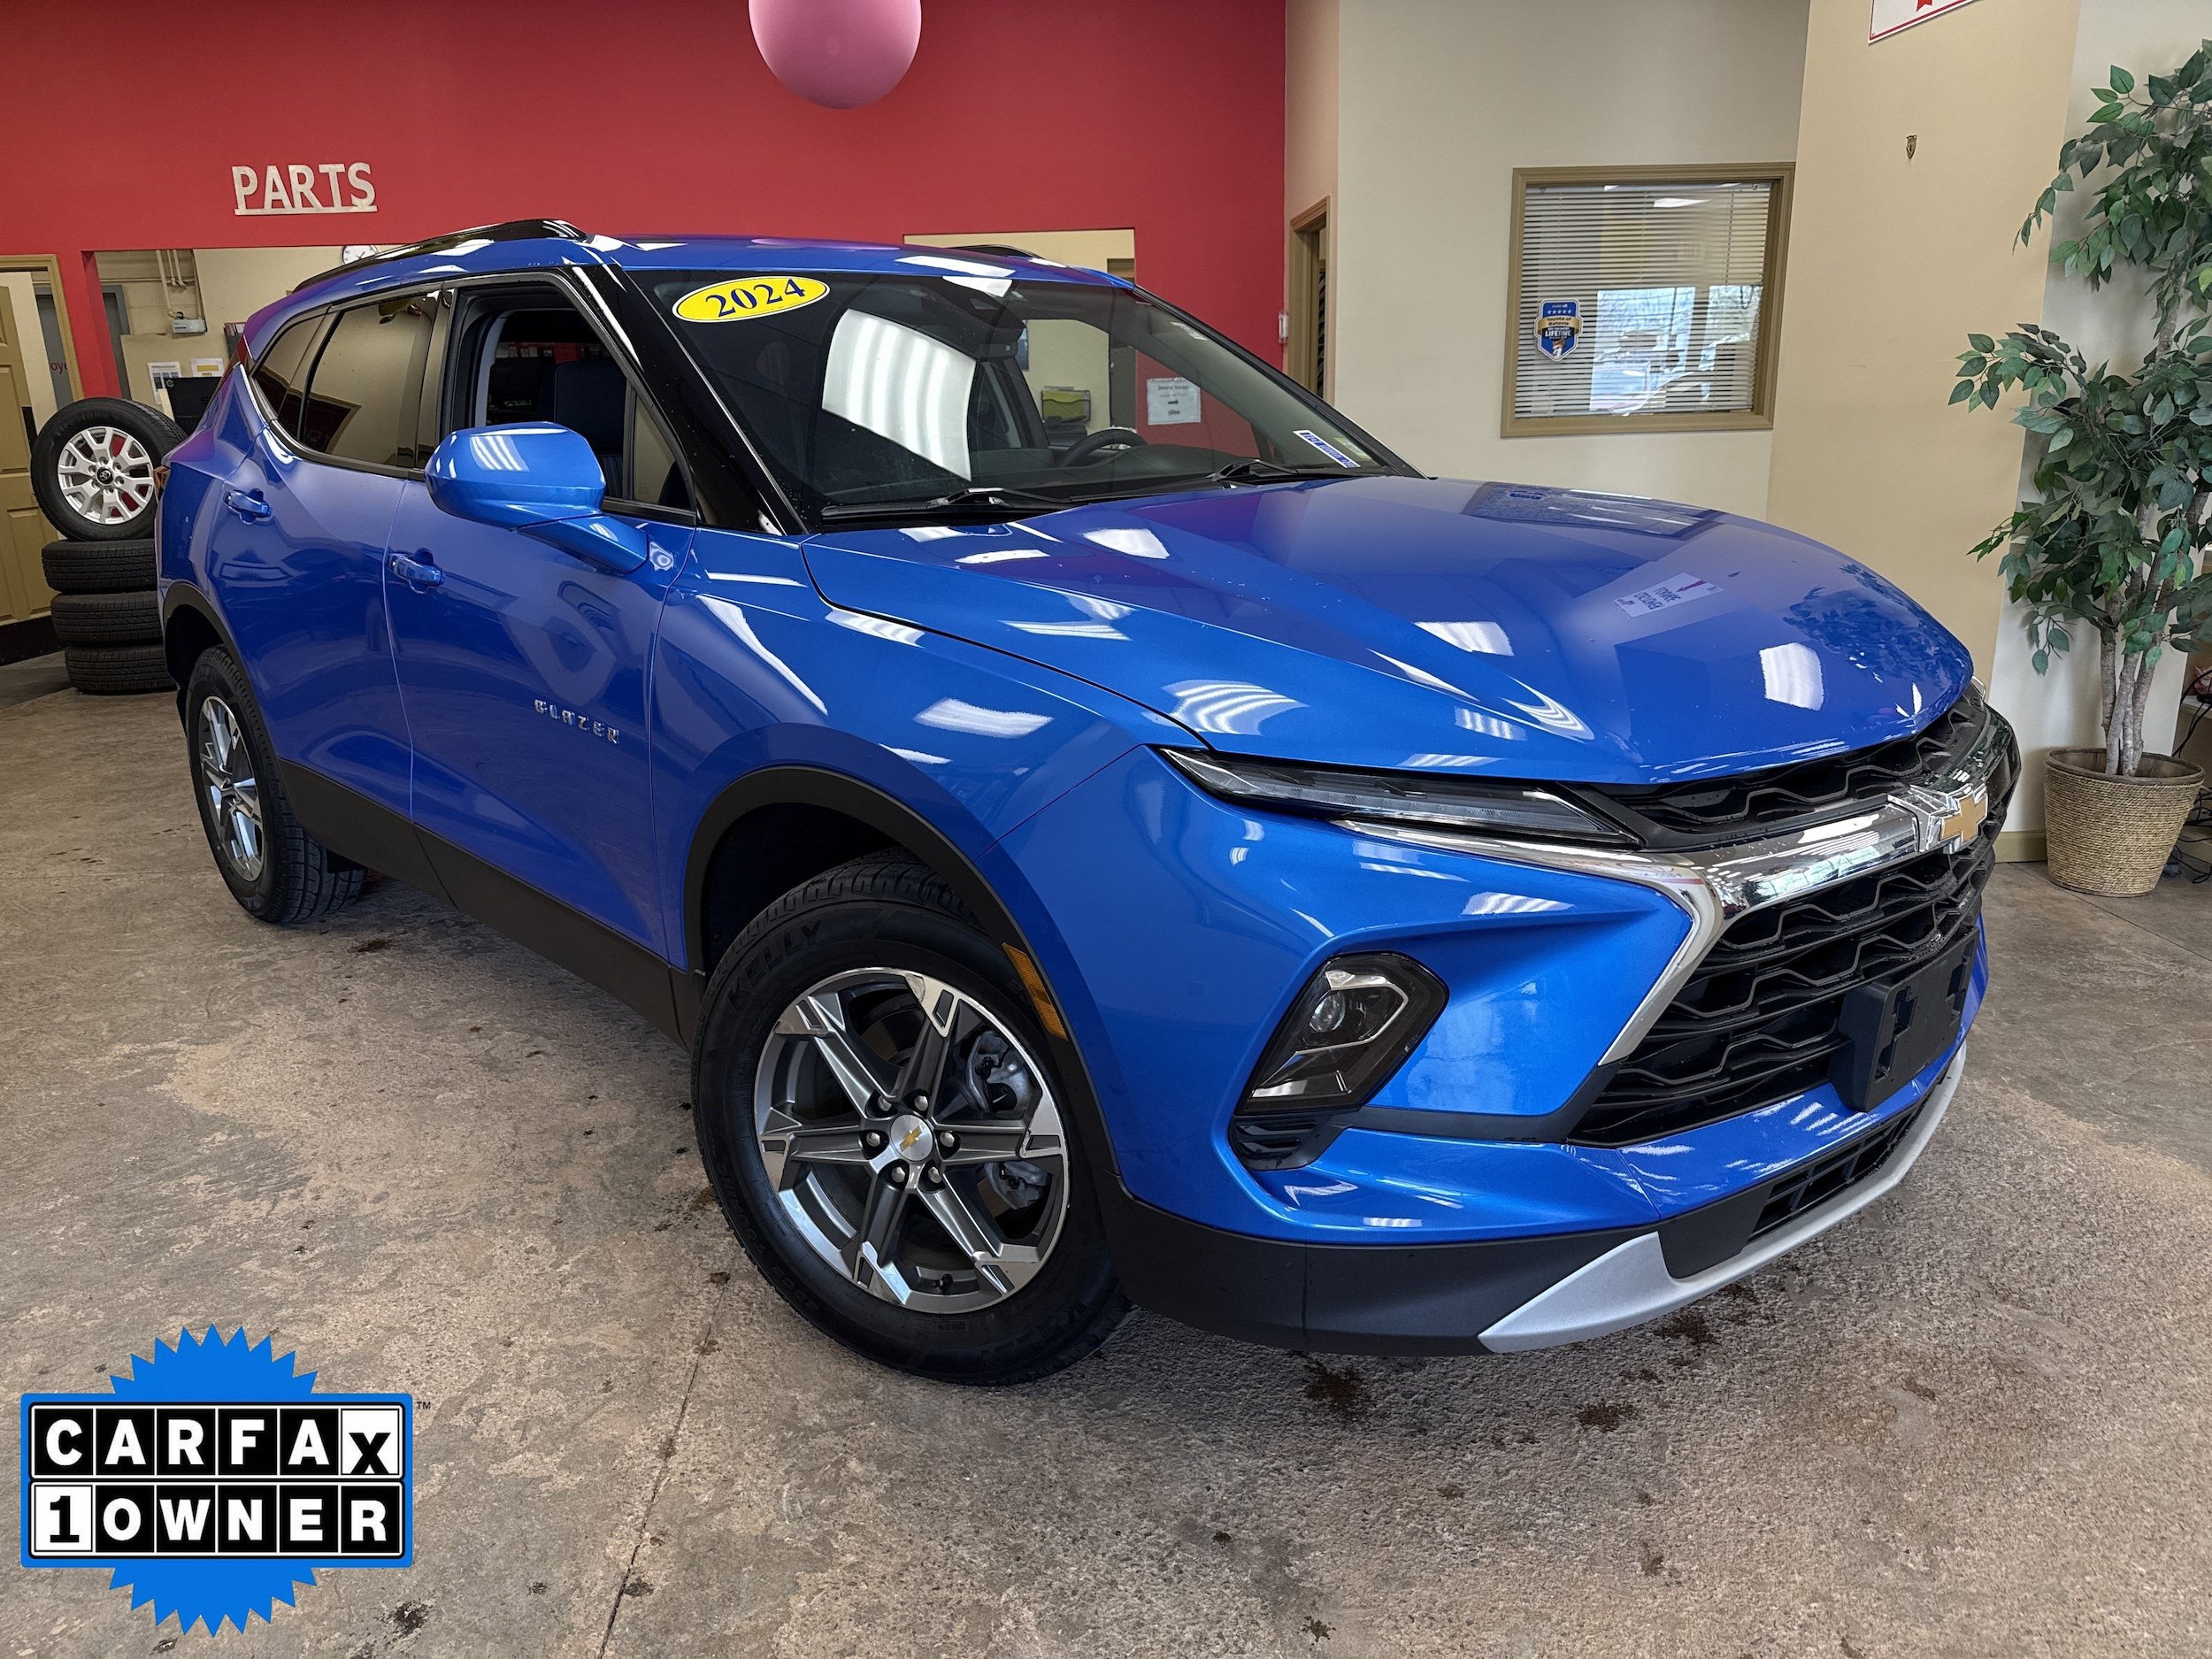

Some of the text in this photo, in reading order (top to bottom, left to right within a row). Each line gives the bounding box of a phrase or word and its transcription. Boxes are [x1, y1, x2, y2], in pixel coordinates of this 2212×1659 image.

[231, 162, 379, 216] PARTS
[705, 279, 805, 318] 2024
[534, 698, 620, 744] BLAZER
[726, 919, 823, 1014] KELLY
